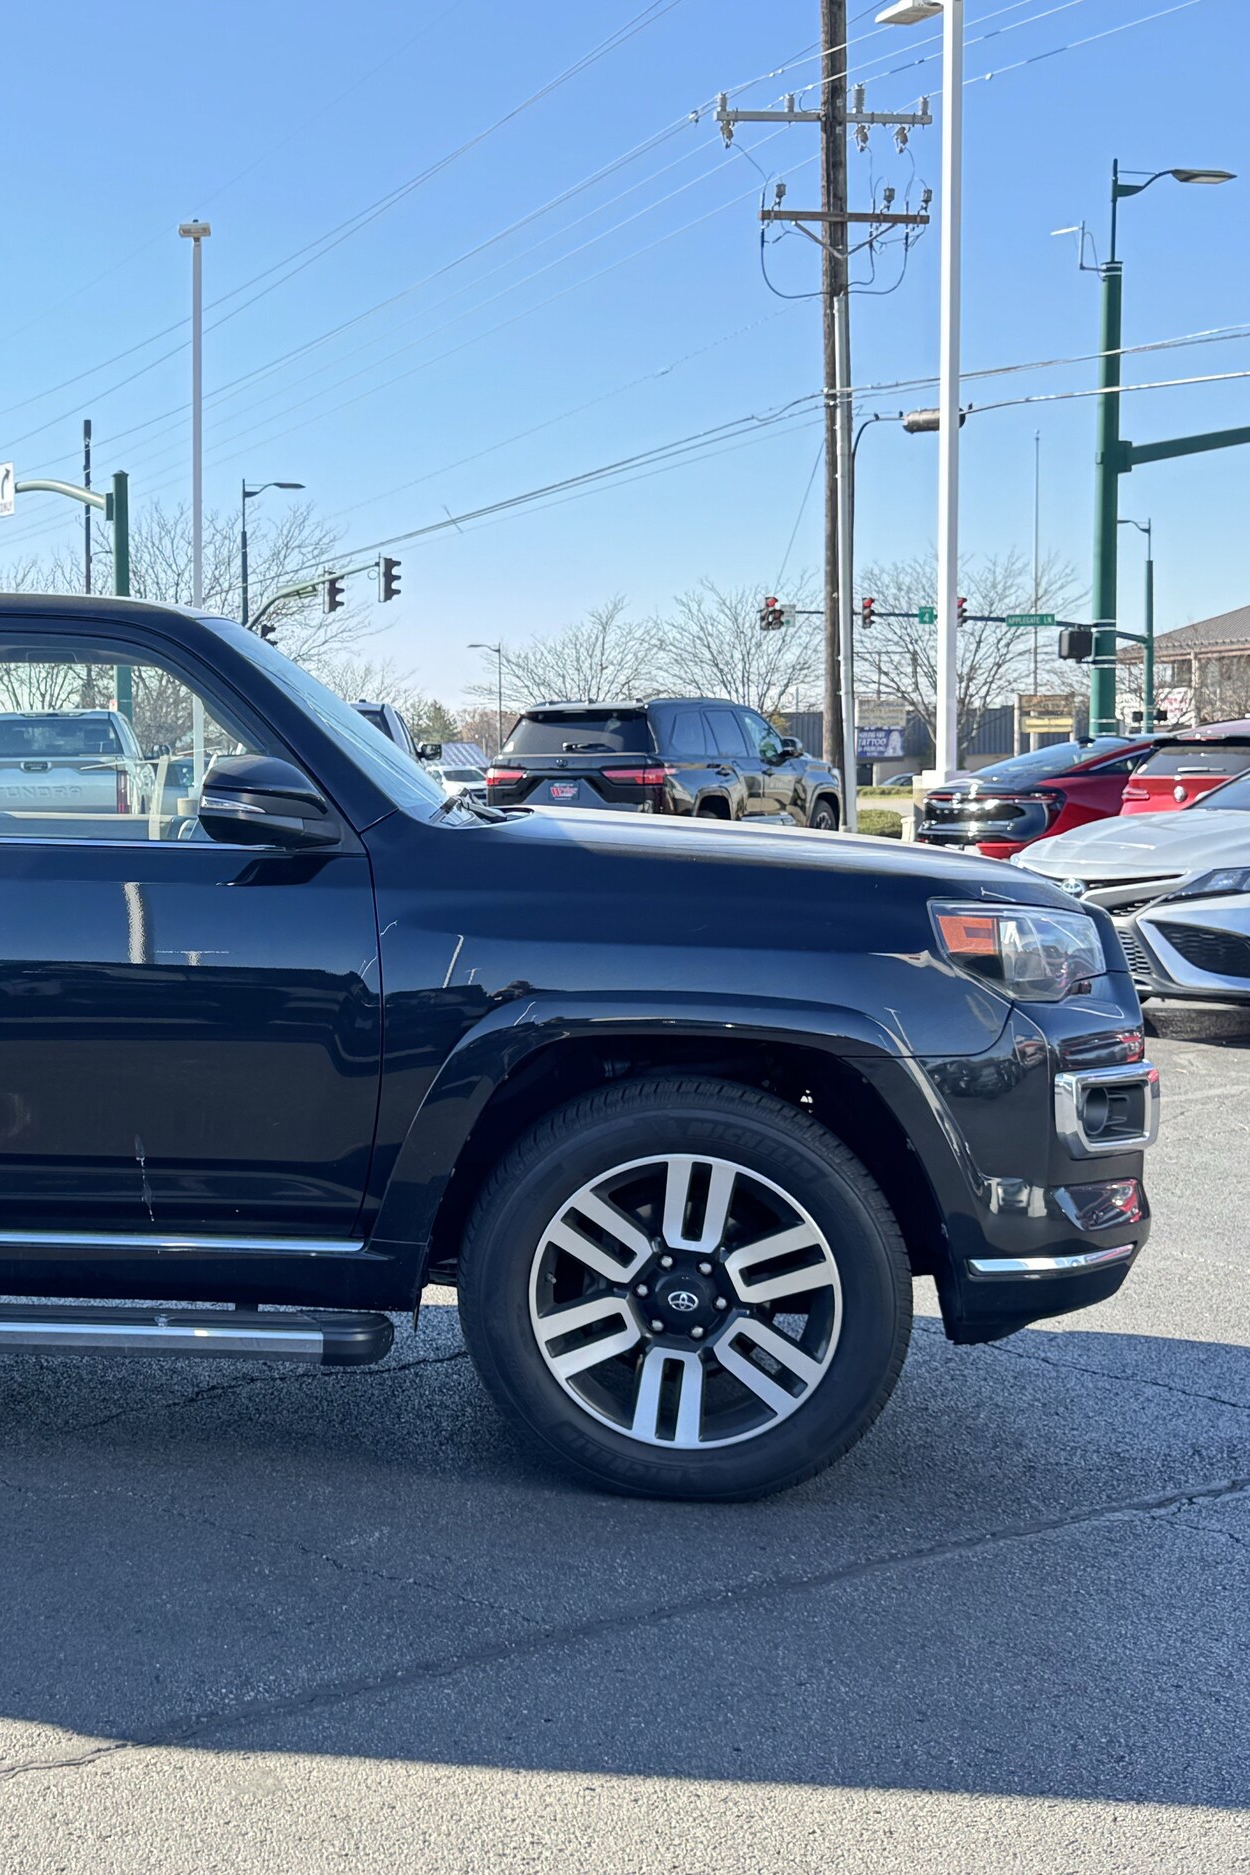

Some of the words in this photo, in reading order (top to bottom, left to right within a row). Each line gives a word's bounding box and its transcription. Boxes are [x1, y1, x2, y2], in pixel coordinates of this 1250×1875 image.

[1008, 616, 1041, 625] APPLEGATE
[1043, 616, 1053, 624] LN
[686, 1120, 820, 1180] MICHELIN
